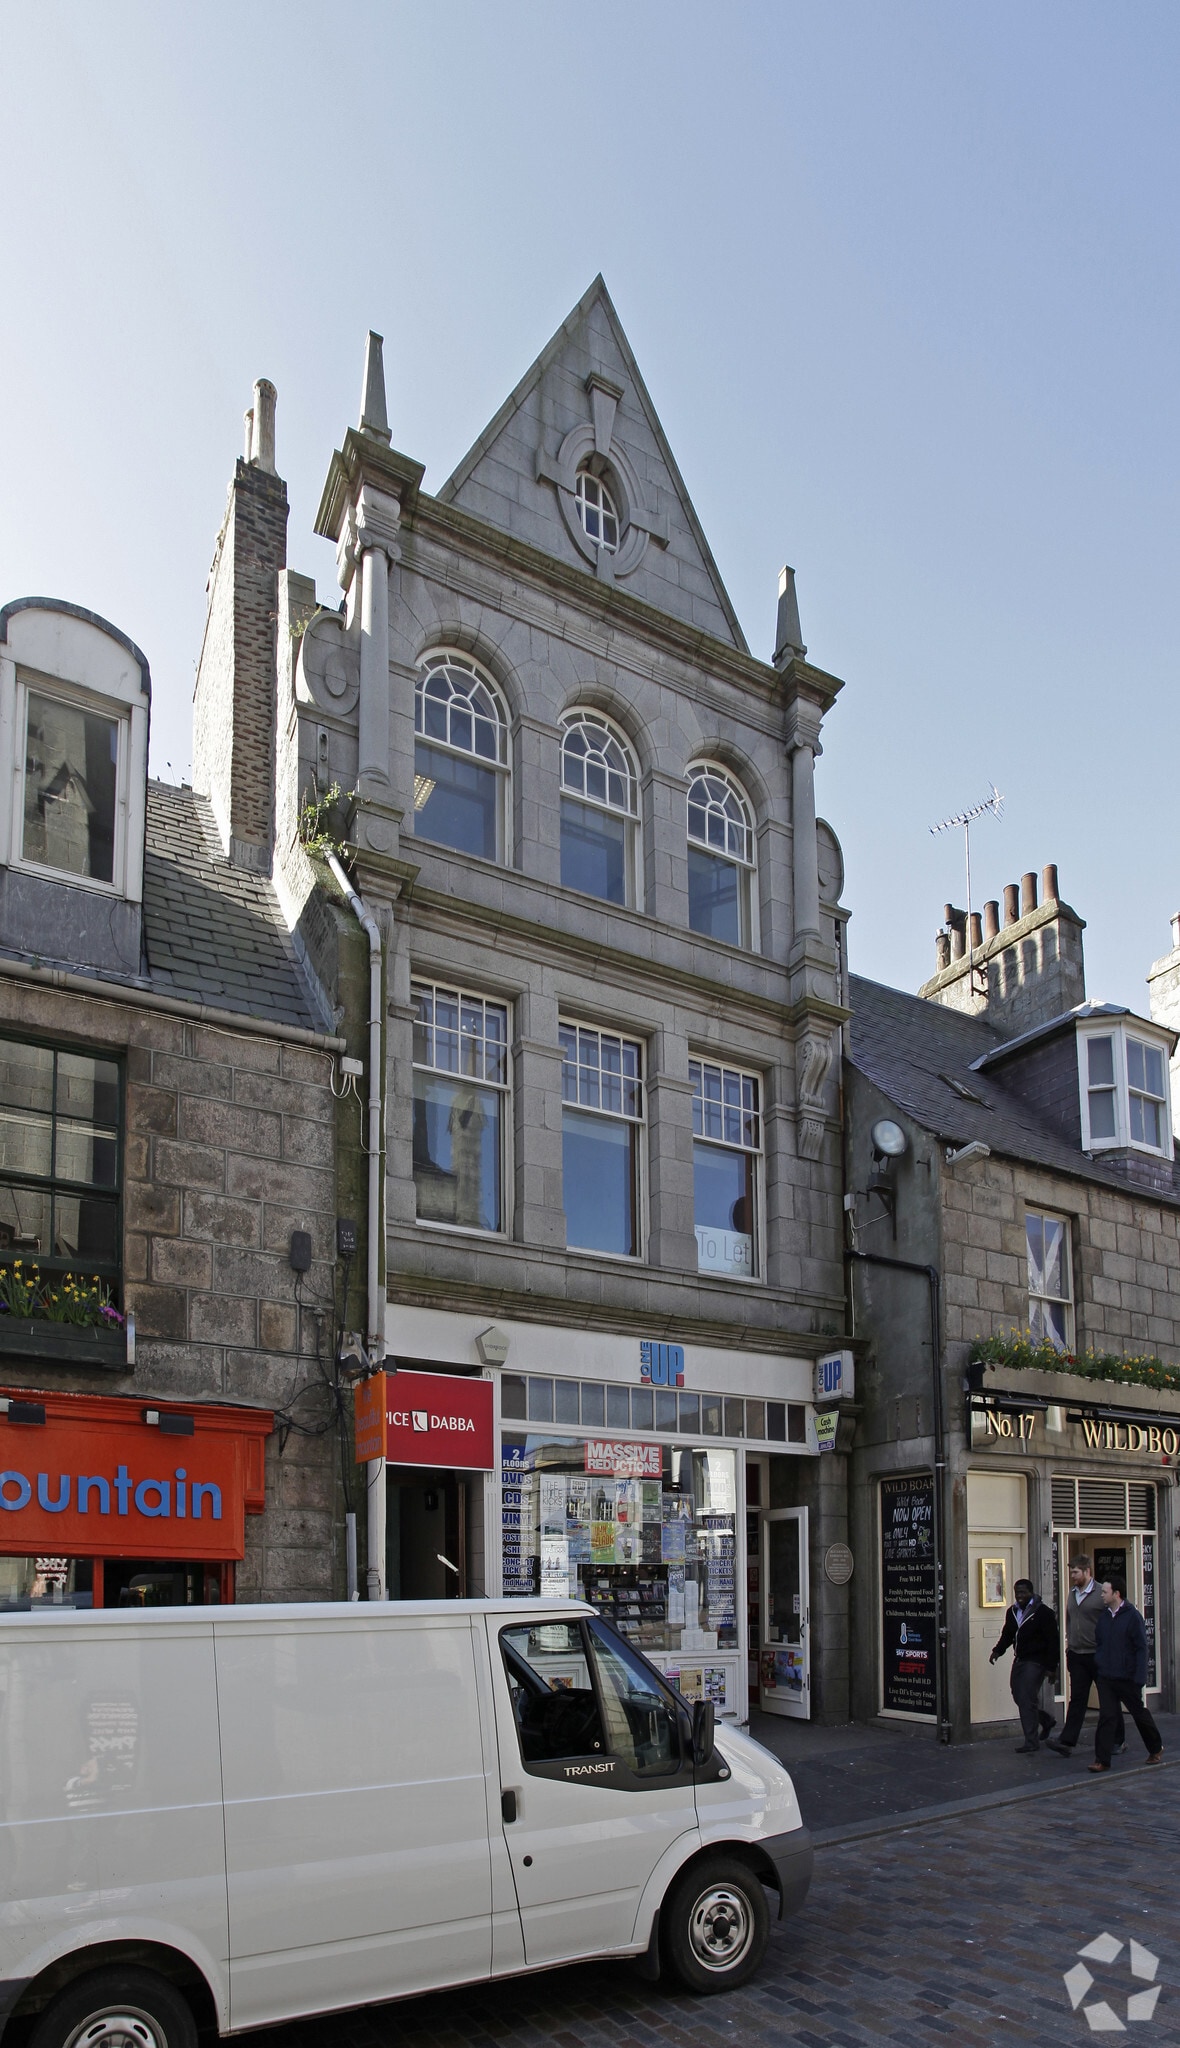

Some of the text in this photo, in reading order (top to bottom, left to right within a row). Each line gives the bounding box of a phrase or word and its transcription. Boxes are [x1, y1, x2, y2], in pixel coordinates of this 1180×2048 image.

[697, 1231, 750, 1265] To Let
[640, 1341, 651, 1376] ONE
[431, 1415, 475, 1432] DABBA
[820, 1417, 831, 1427] Cash
[986, 1410, 1035, 1439] No. 17
[818, 1426, 834, 1436] machine
[1082, 1419, 1180, 1456] WILD BO
[512, 1448, 520, 1460] 2
[588, 1442, 660, 1463] MASSIVE
[503, 1460, 530, 1468] FLOORS
[588, 1459, 660, 1473] REDUCTIONS
[0, 1466, 221, 1519] ountain
[884, 1481, 908, 1493] WILD
[893, 1505, 931, 1523] NOW OPEN
[908, 1539, 917, 1547] HD
[1043, 1558, 1051, 1569] 17
[905, 1651, 928, 1659] SPORTS
[899, 1661, 926, 1675] ESPN
[563, 1762, 617, 1777] TRANSIT
